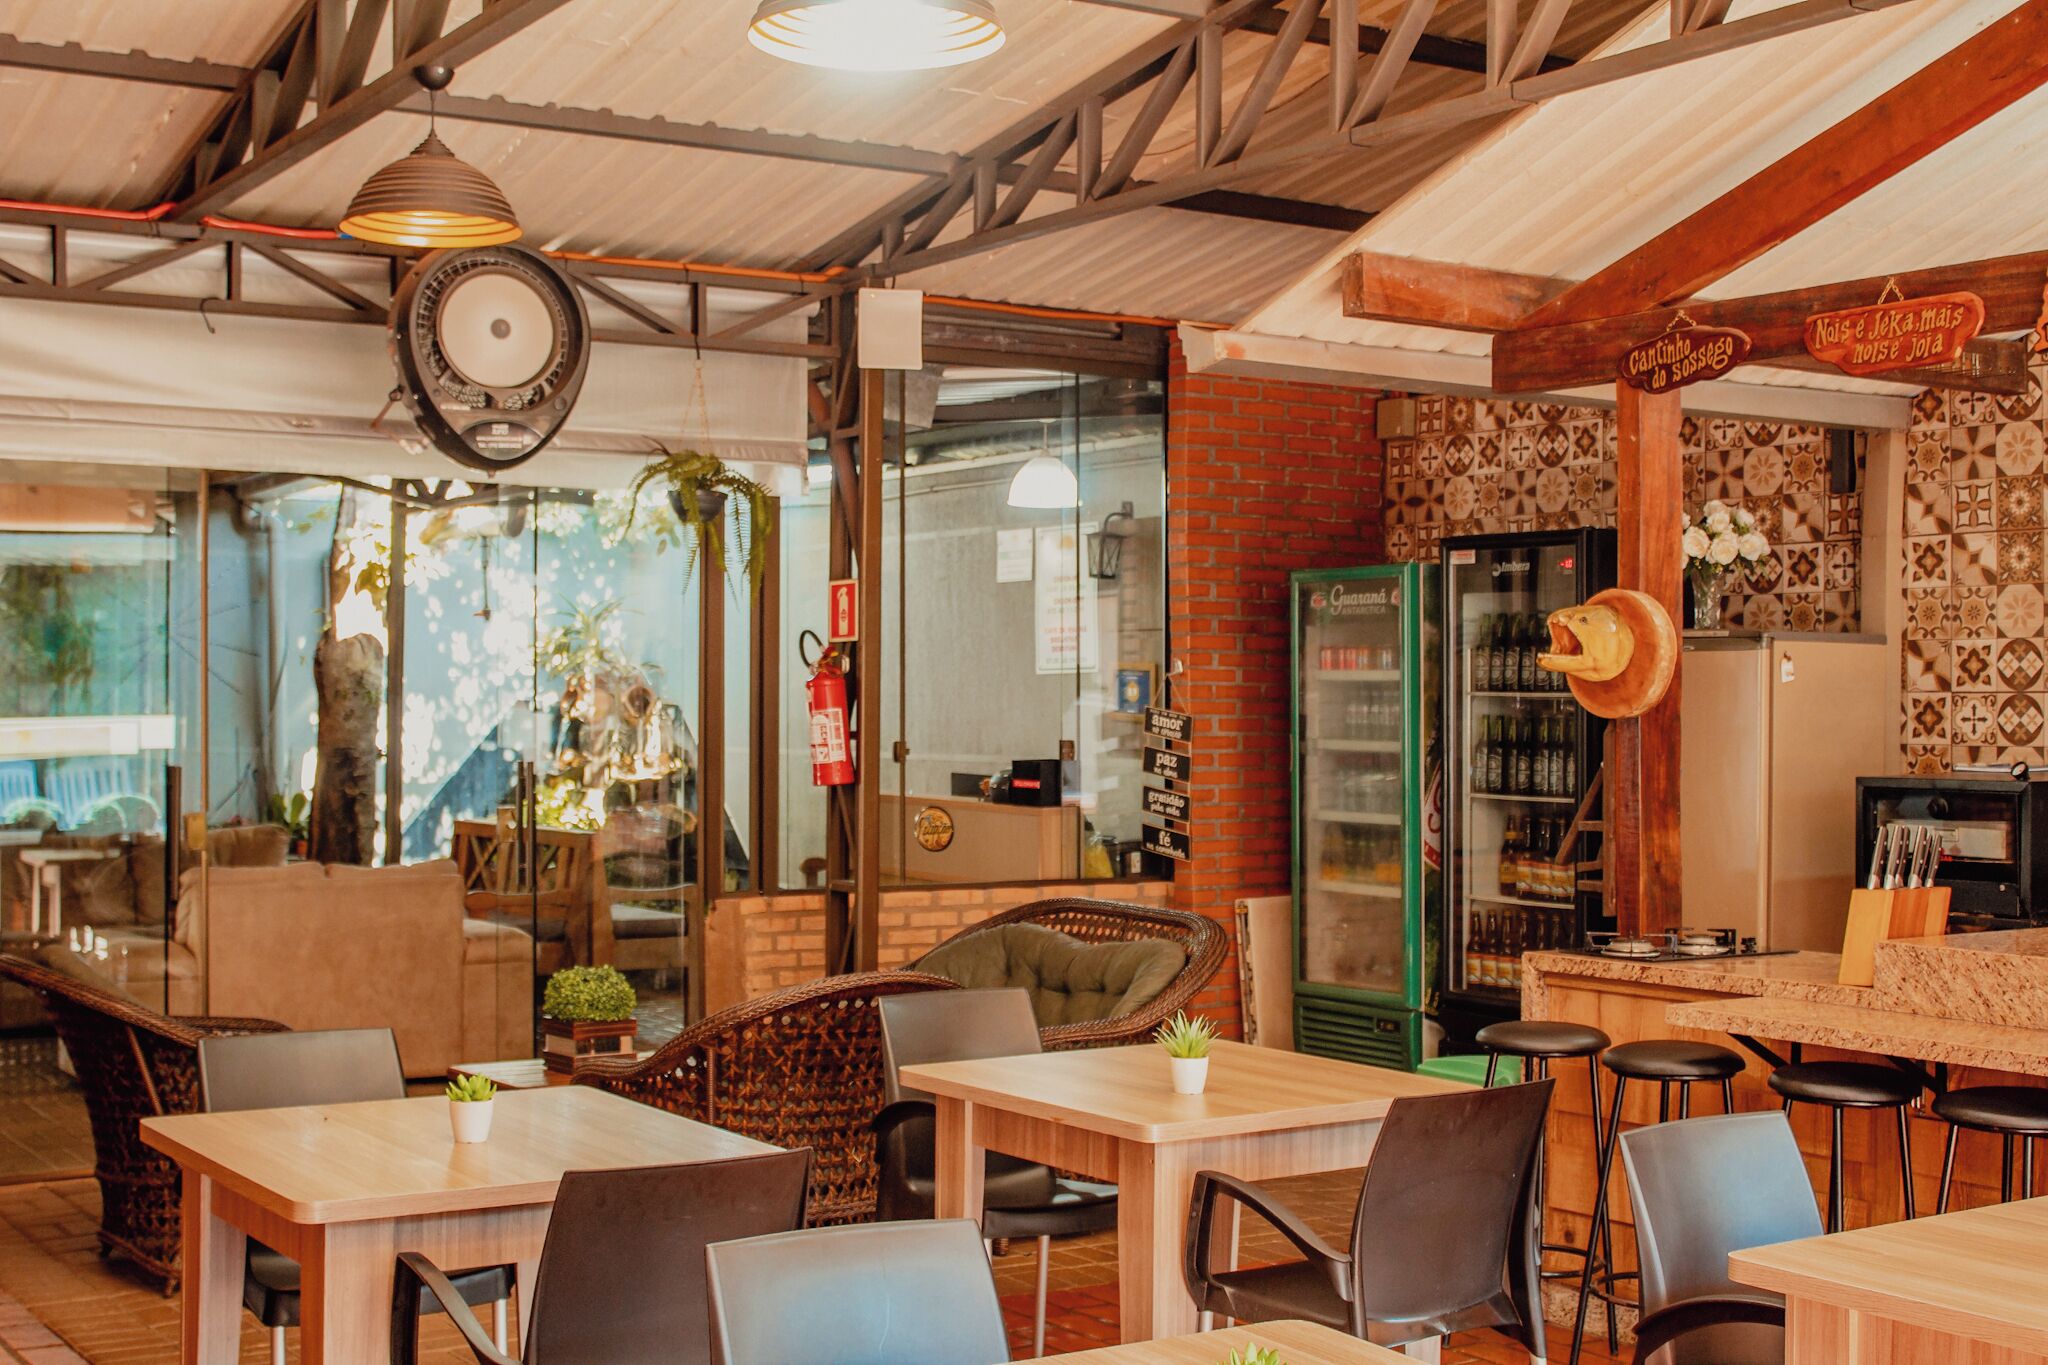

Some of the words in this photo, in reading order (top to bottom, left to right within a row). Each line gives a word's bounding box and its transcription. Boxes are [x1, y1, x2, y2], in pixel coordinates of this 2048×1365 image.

[1815, 318, 1850, 349] Nois
[1855, 312, 1869, 339] é
[1918, 305, 1965, 333] mais
[1629, 333, 1691, 376] Cantinho
[1905, 332, 1943, 362] joia
[1652, 366, 1667, 389] do
[1672, 336, 1733, 382] sossego
[1331, 584, 1388, 616] Guaraná
[1151, 714, 1184, 731] amor
[1156, 753, 1178, 768] paz
[1148, 792, 1185, 808] gratidão
[1159, 830, 1171, 847] fé
